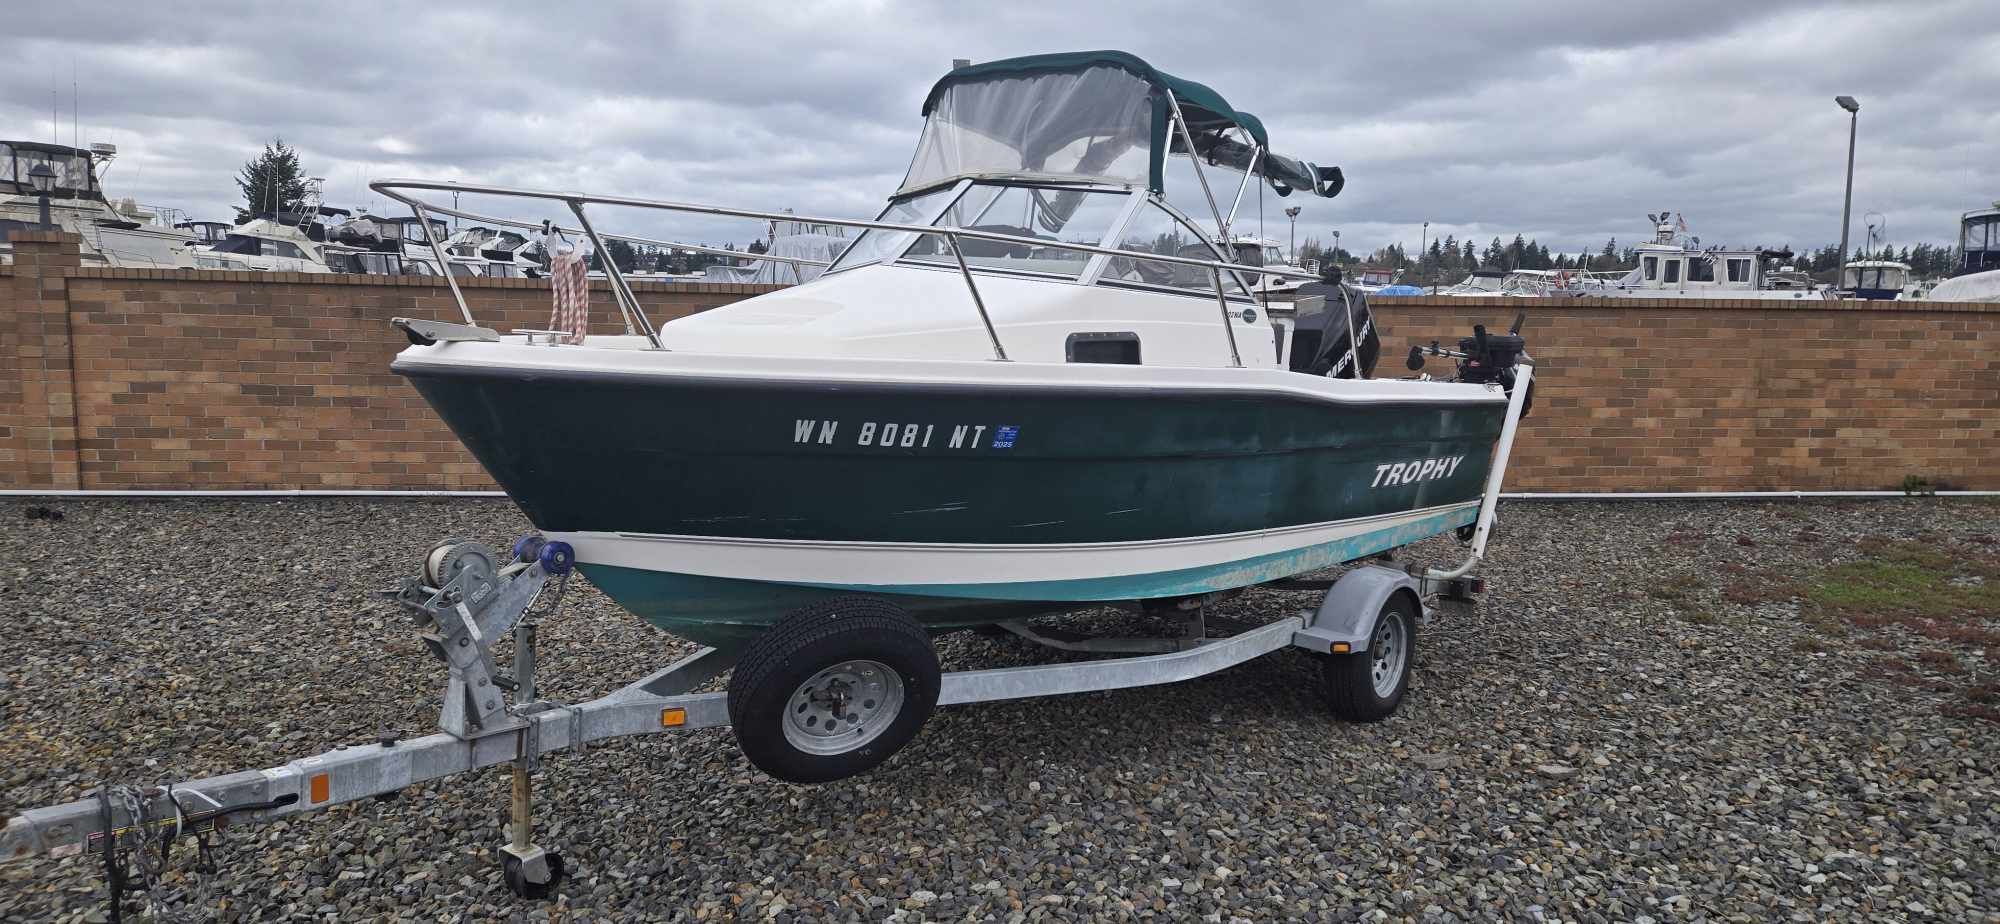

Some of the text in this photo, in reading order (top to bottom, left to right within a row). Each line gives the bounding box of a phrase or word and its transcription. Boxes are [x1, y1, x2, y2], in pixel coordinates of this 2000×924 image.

[1326, 315, 1371, 379] MERURY
[793, 419, 838, 445] WN
[858, 422, 934, 448] 8081
[949, 425, 987, 449] NT
[1370, 455, 1465, 488] TROPHY
